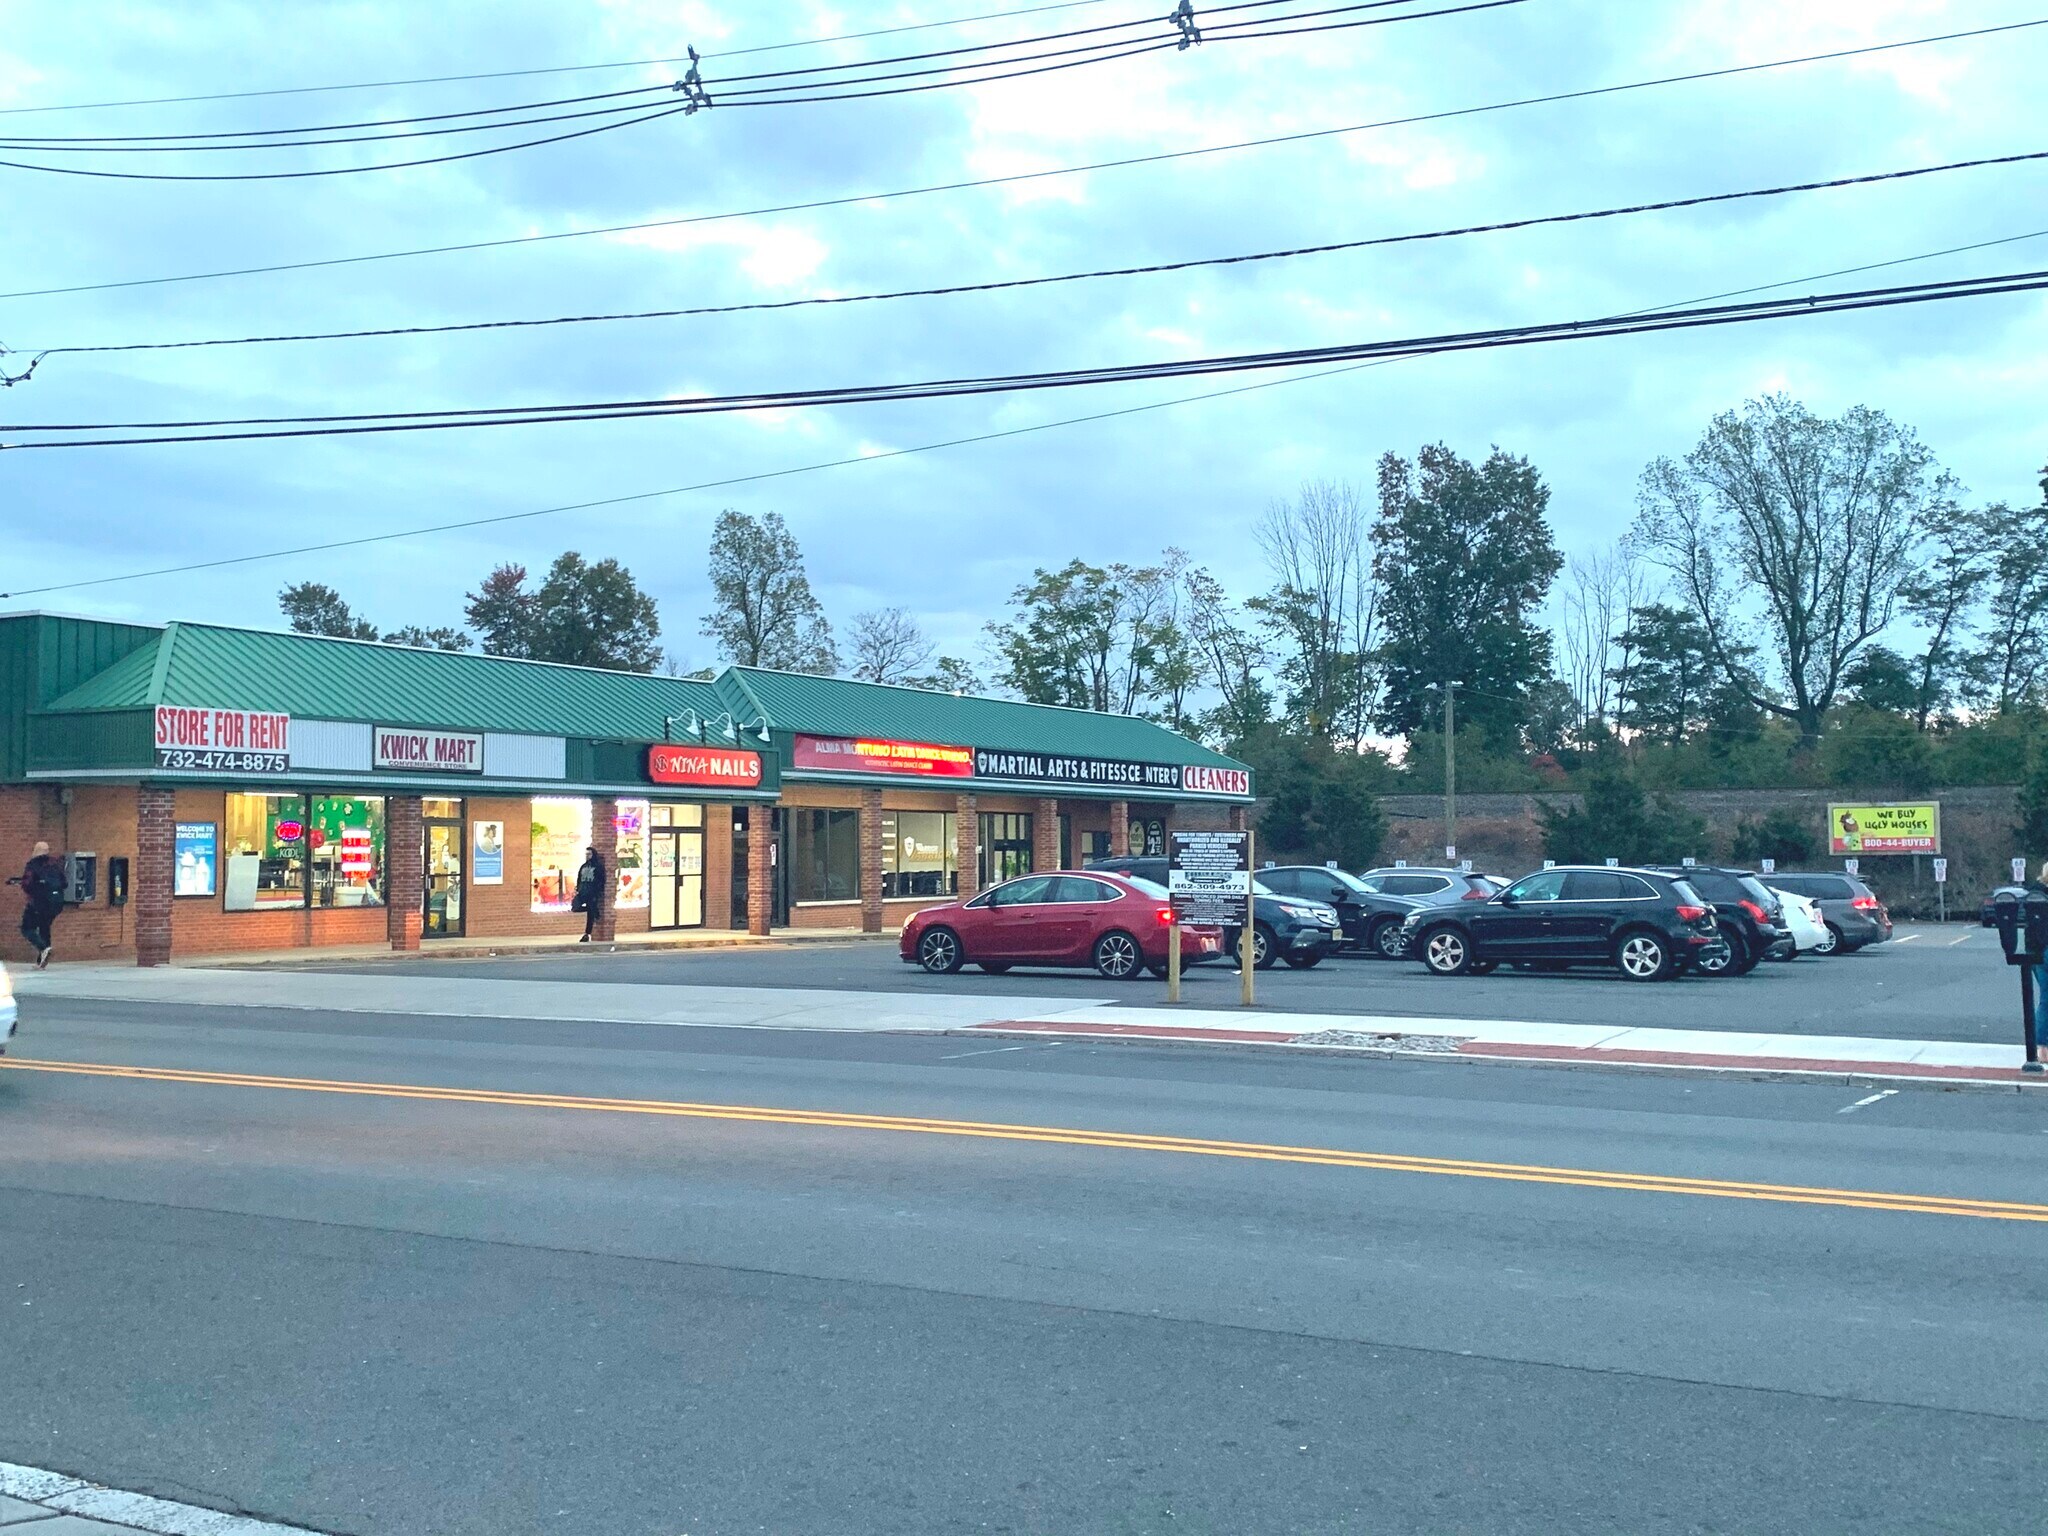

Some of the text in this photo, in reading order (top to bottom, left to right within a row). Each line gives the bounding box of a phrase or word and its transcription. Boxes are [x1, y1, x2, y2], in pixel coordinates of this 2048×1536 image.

[157, 707, 289, 750] STORE FOR RENT
[381, 734, 477, 763] KWICK MART
[815, 742, 841, 754] ALMA
[160, 750, 285, 771] 732-474-8875
[388, 760, 467, 770] CONVENIENCE STORE
[670, 756, 708, 774] NINA
[710, 758, 759, 778] NAILS
[988, 754, 1044, 776] MARTIAL
[1047, 758, 1078, 779] ARTS
[1080, 761, 1089, 779] &
[1184, 766, 1248, 793] CLEANERS
[1877, 809, 1916, 819] WE BUY
[1865, 820, 1927, 830] UGLY HOUSES
[1864, 838, 1931, 847] 800-44-BUYER
[280, 848, 299, 858] KOOL
